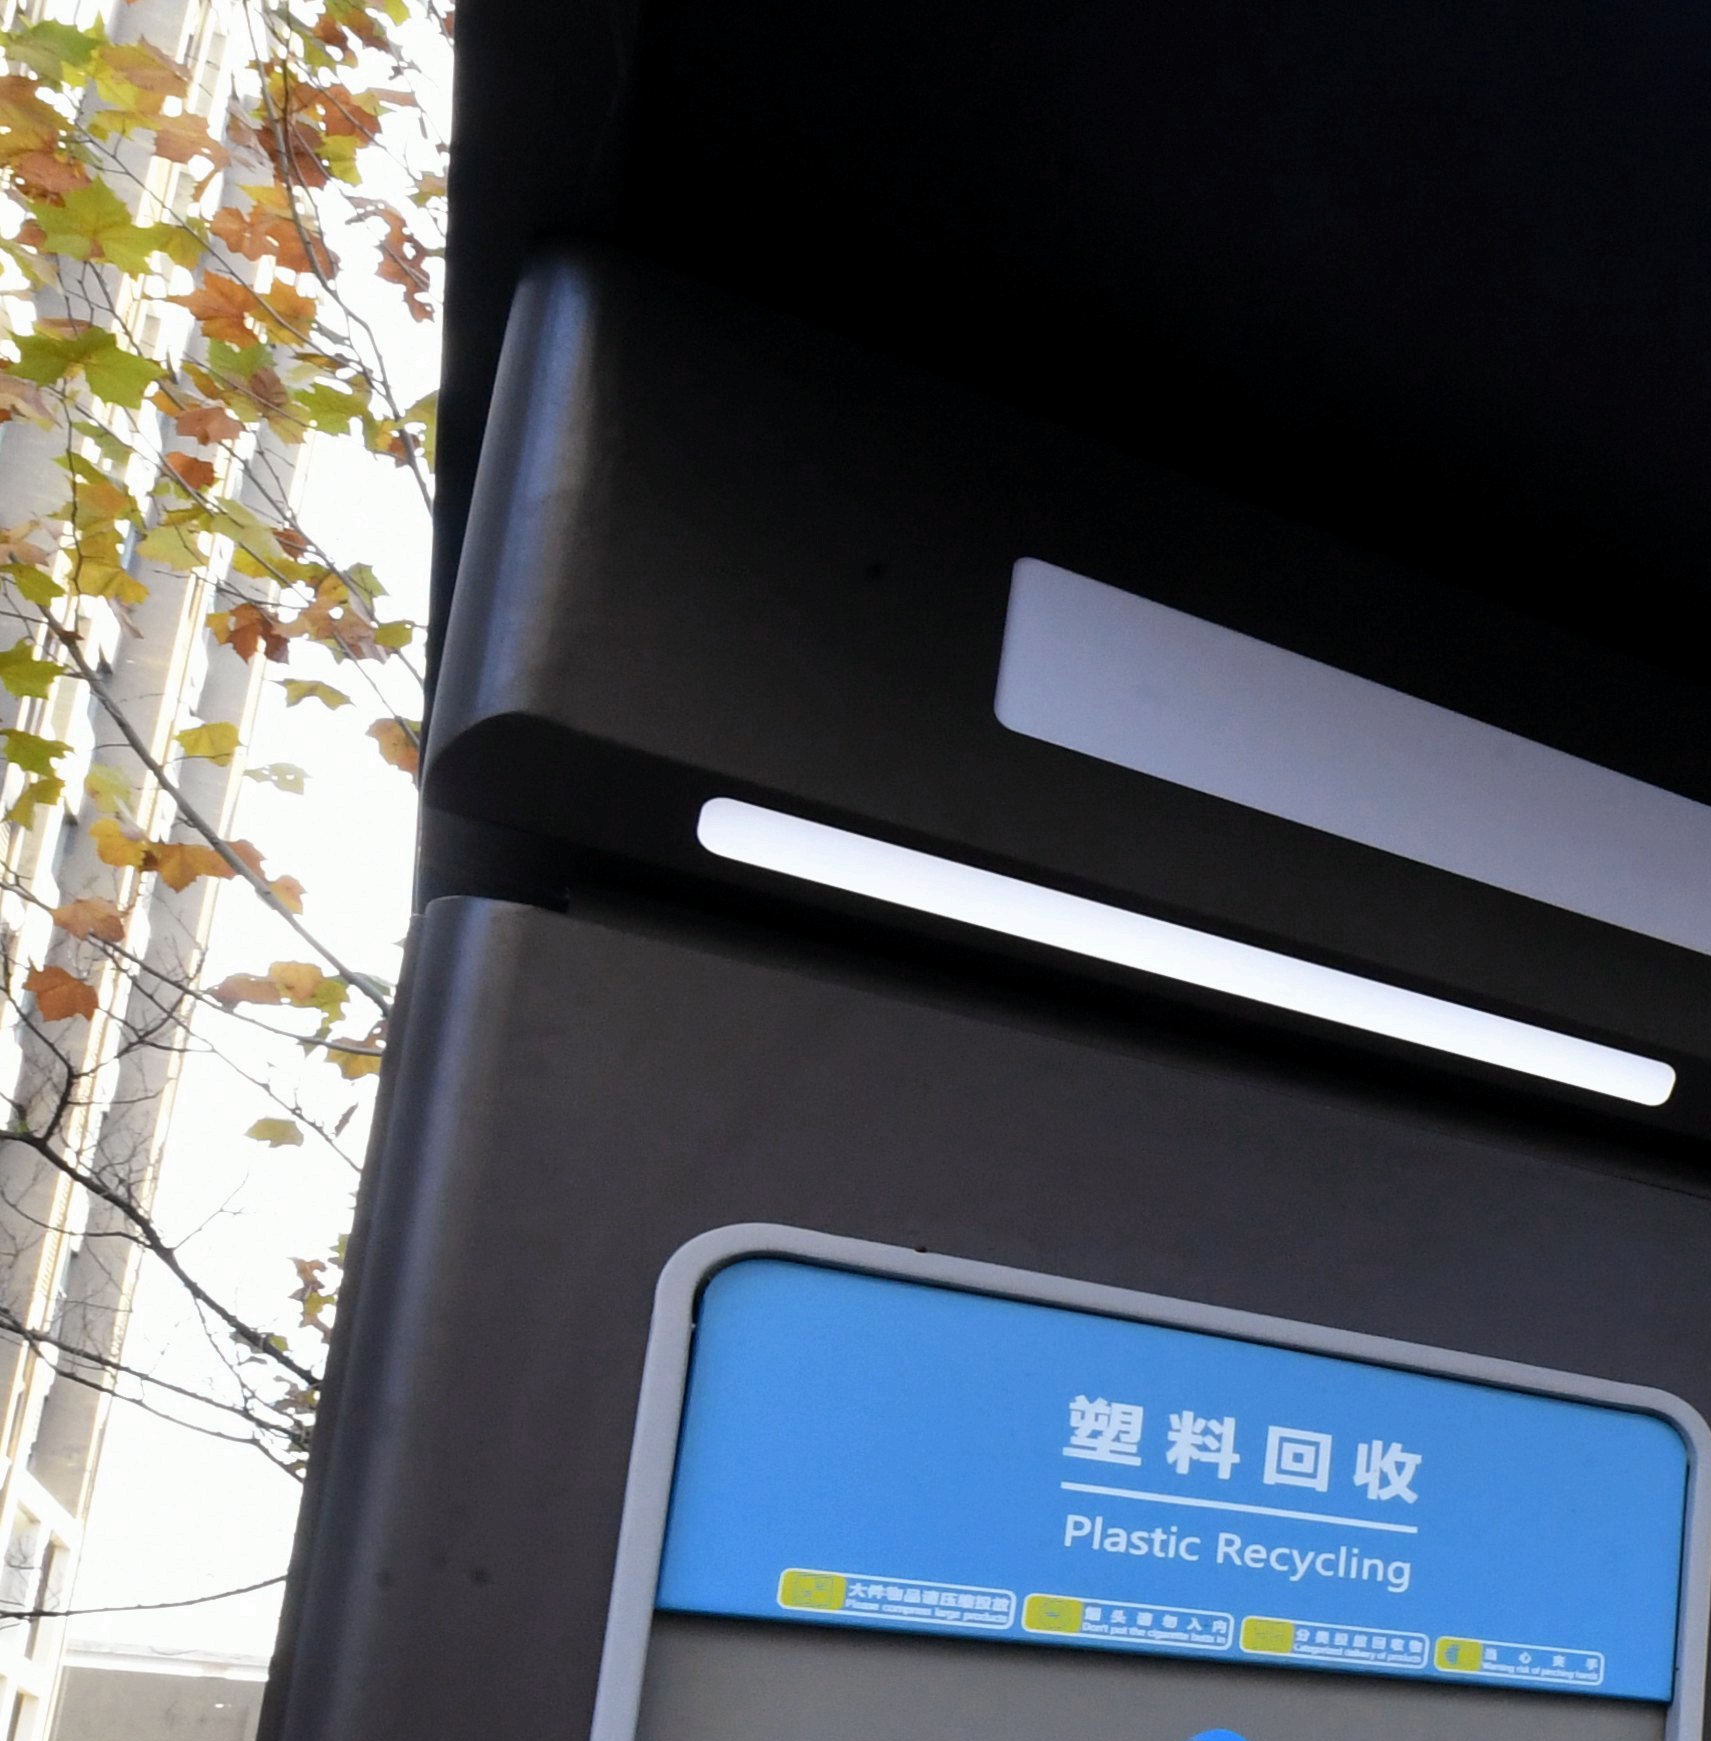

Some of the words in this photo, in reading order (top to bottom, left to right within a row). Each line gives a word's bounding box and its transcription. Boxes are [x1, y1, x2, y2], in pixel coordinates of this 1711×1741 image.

[1062, 1394, 1423, 1505] 塑料回收
[1064, 1514, 1202, 1562] Plastic
[1216, 1532, 1412, 1593] Recycling
